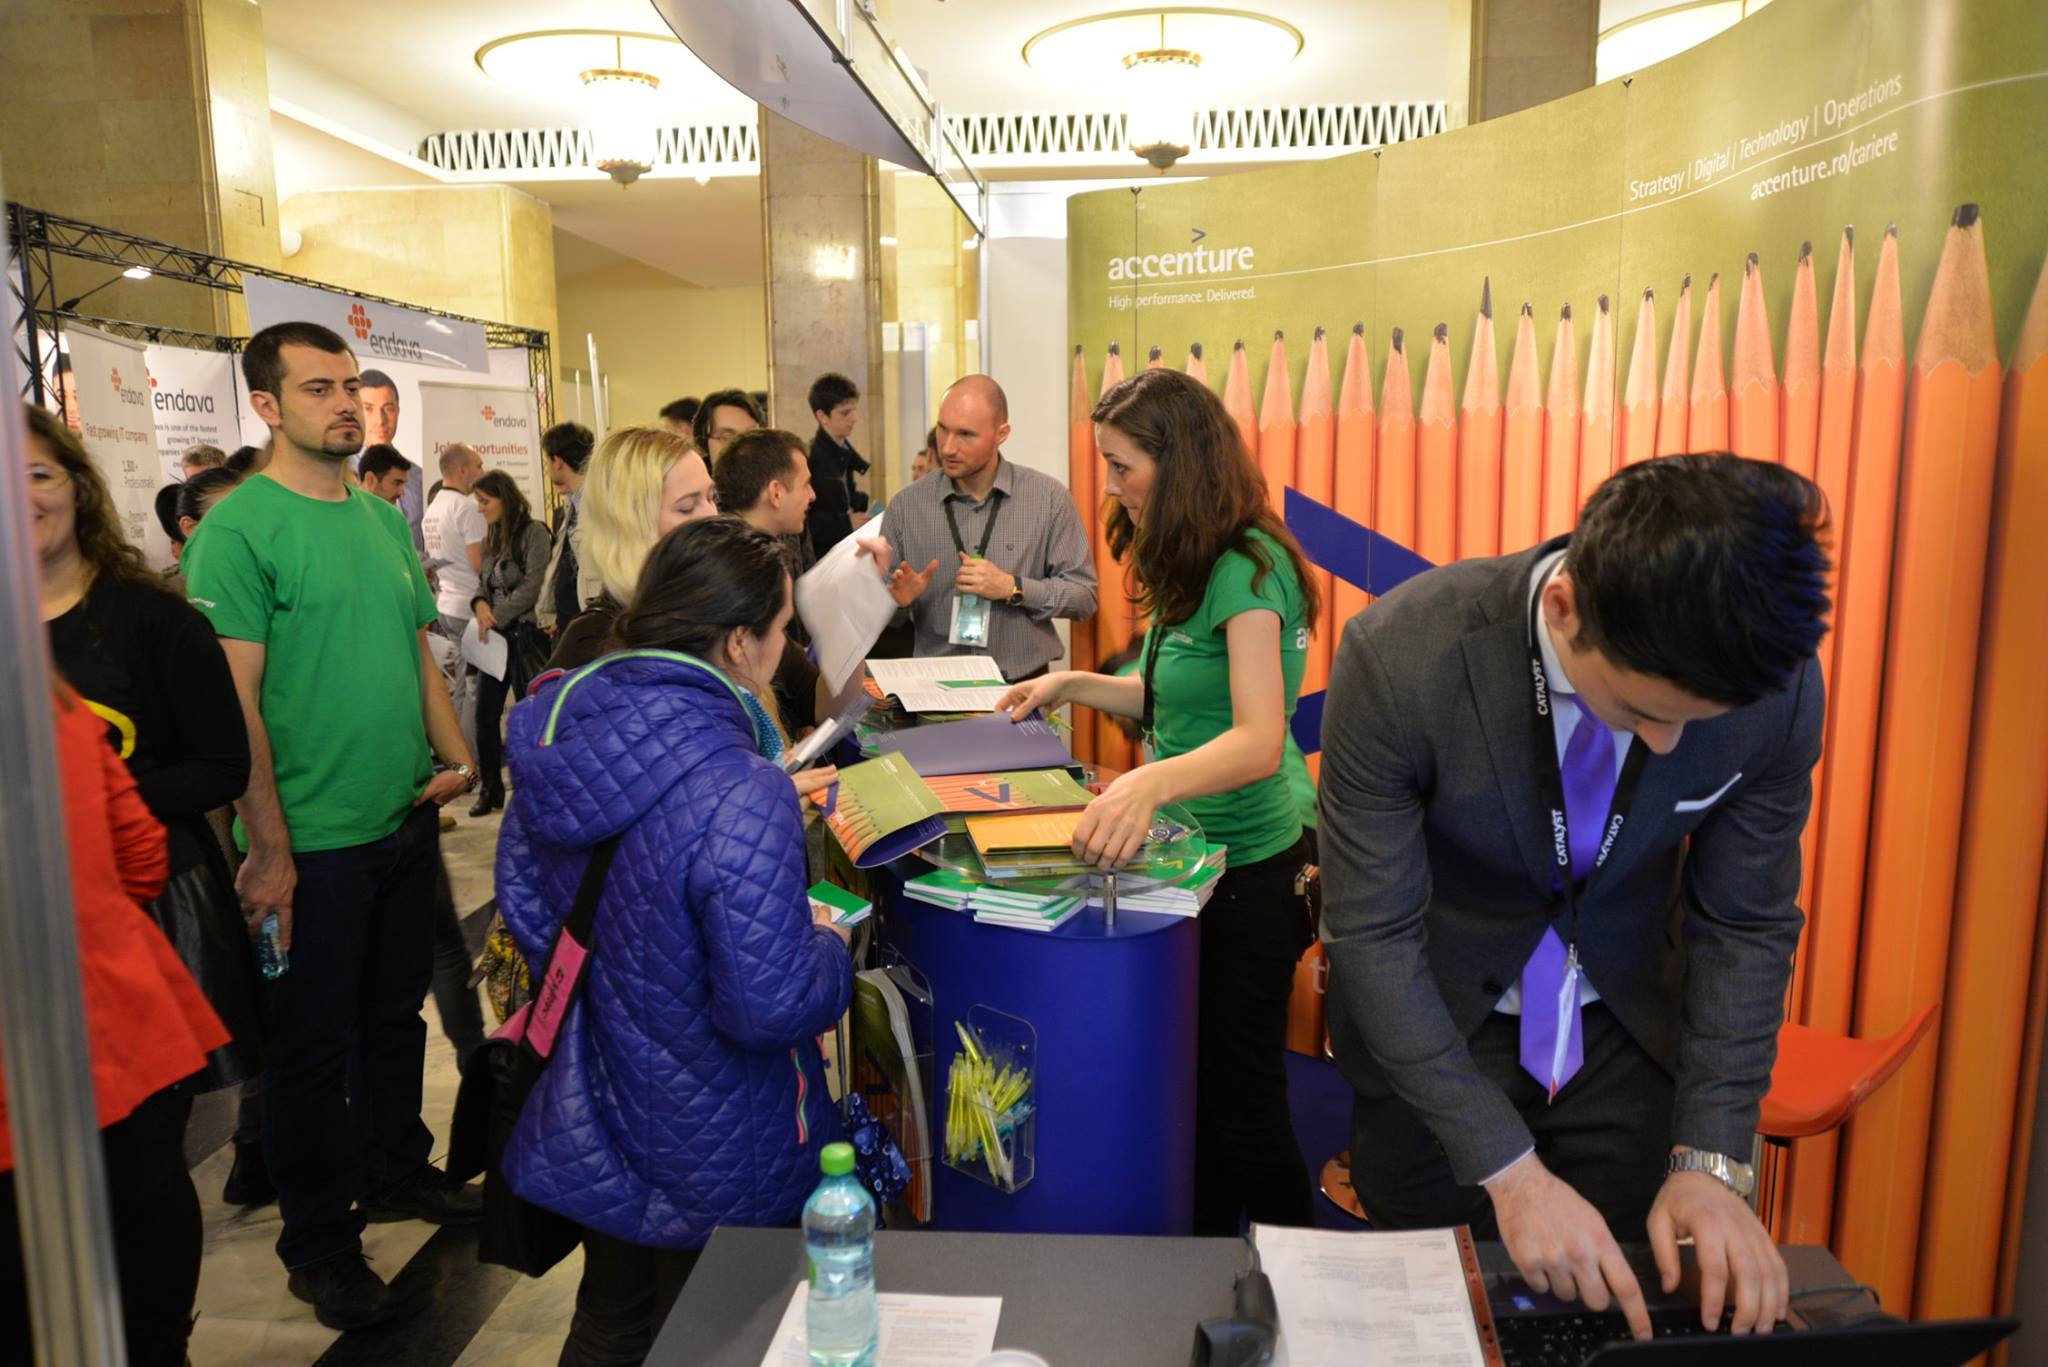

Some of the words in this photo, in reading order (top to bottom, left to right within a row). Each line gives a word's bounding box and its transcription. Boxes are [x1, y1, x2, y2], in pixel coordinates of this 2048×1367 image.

[1629, 169, 1685, 202] Strategy
[1694, 150, 1730, 184] Digital
[1739, 115, 1809, 161] Technology
[1823, 74, 1903, 128] Operations
[1750, 131, 1899, 201] accenture.ro/cariere
[1108, 244, 1255, 281] accenture
[1108, 295, 1132, 311] High
[1136, 292, 1204, 307] performance.
[1207, 286, 1256, 300] Delivered.
[369, 332, 423, 361] endava
[120, 384, 145, 407] endava
[154, 388, 215, 414] endava
[493, 415, 527, 428] endava
[1531, 657, 1549, 716] CATALYST
[1550, 808, 1568, 867] CATALYST
